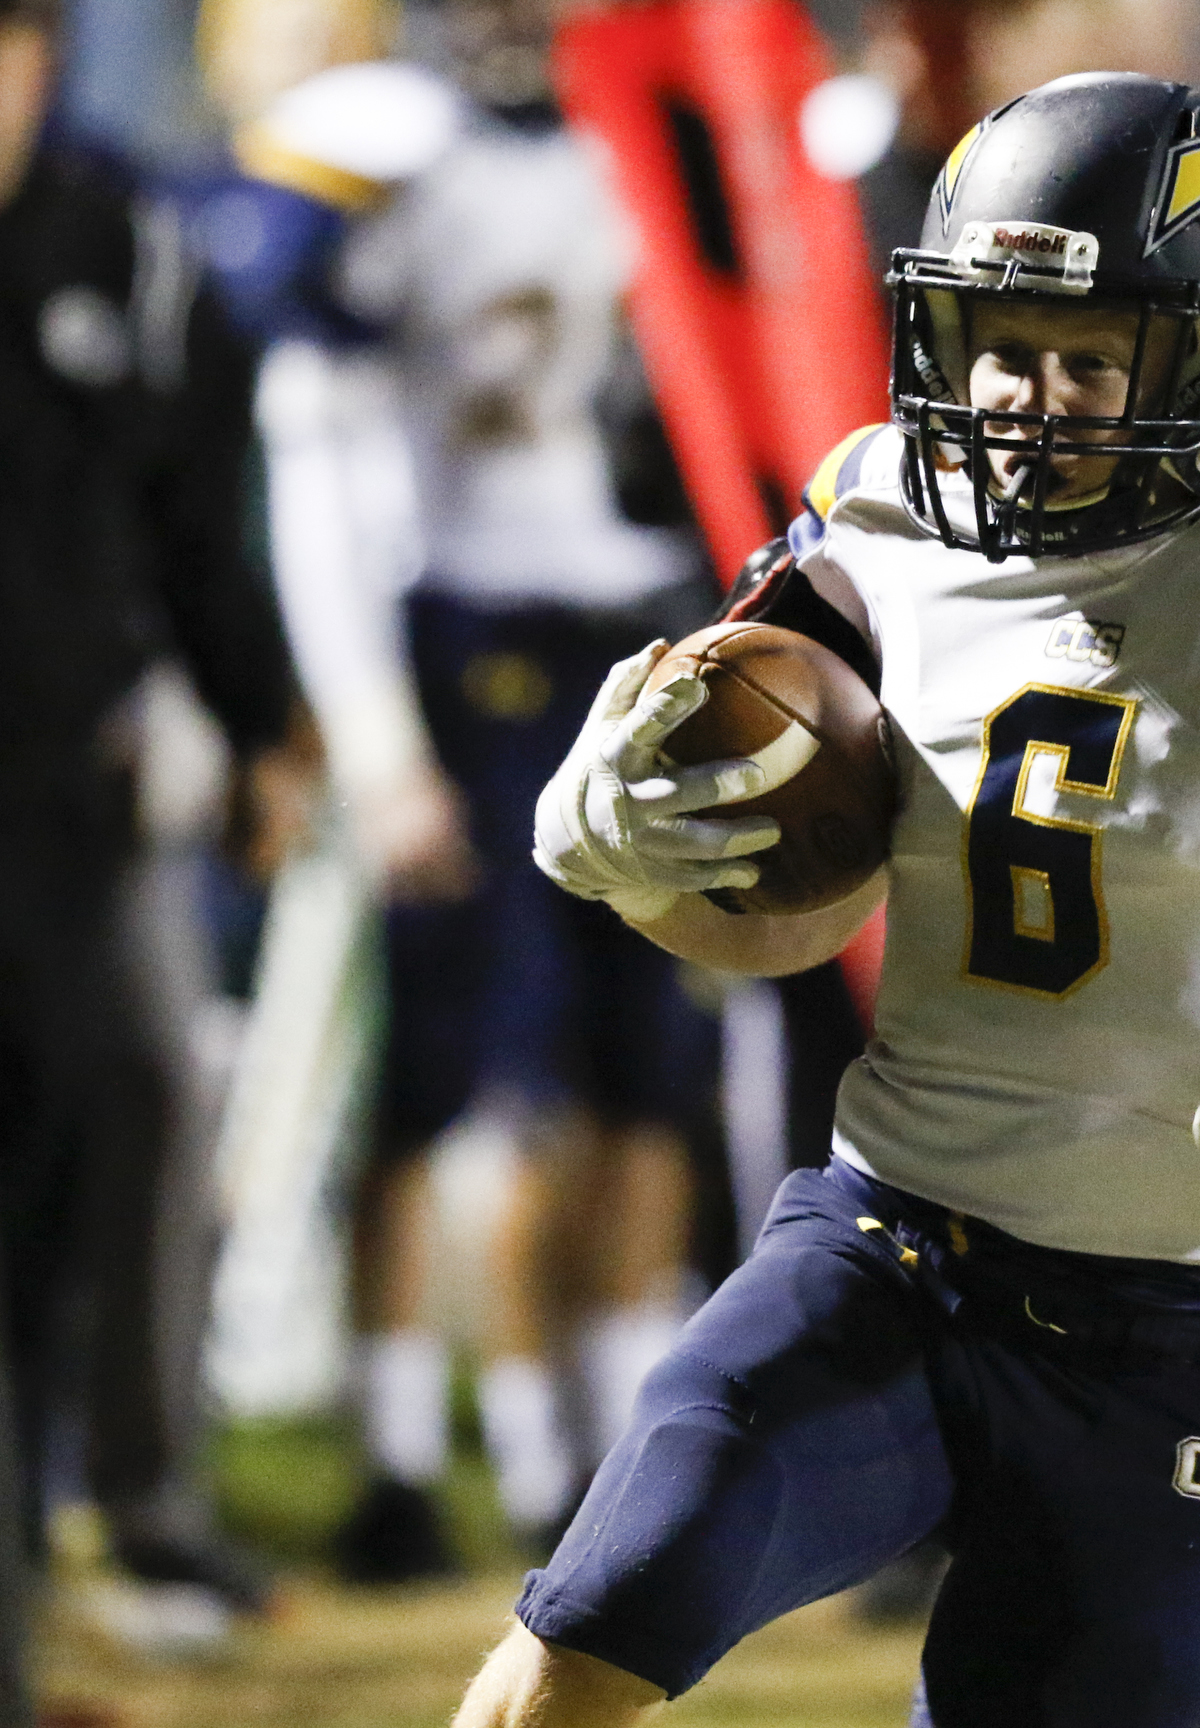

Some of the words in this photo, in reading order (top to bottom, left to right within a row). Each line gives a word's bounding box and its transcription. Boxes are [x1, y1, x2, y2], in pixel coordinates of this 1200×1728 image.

[991, 227, 1068, 254] Riddell
[913, 342, 959, 404] iddell
[1016, 526, 1065, 541] Riell
[1044, 618, 1126, 668] CCS
[961, 681, 1138, 1001] 6
